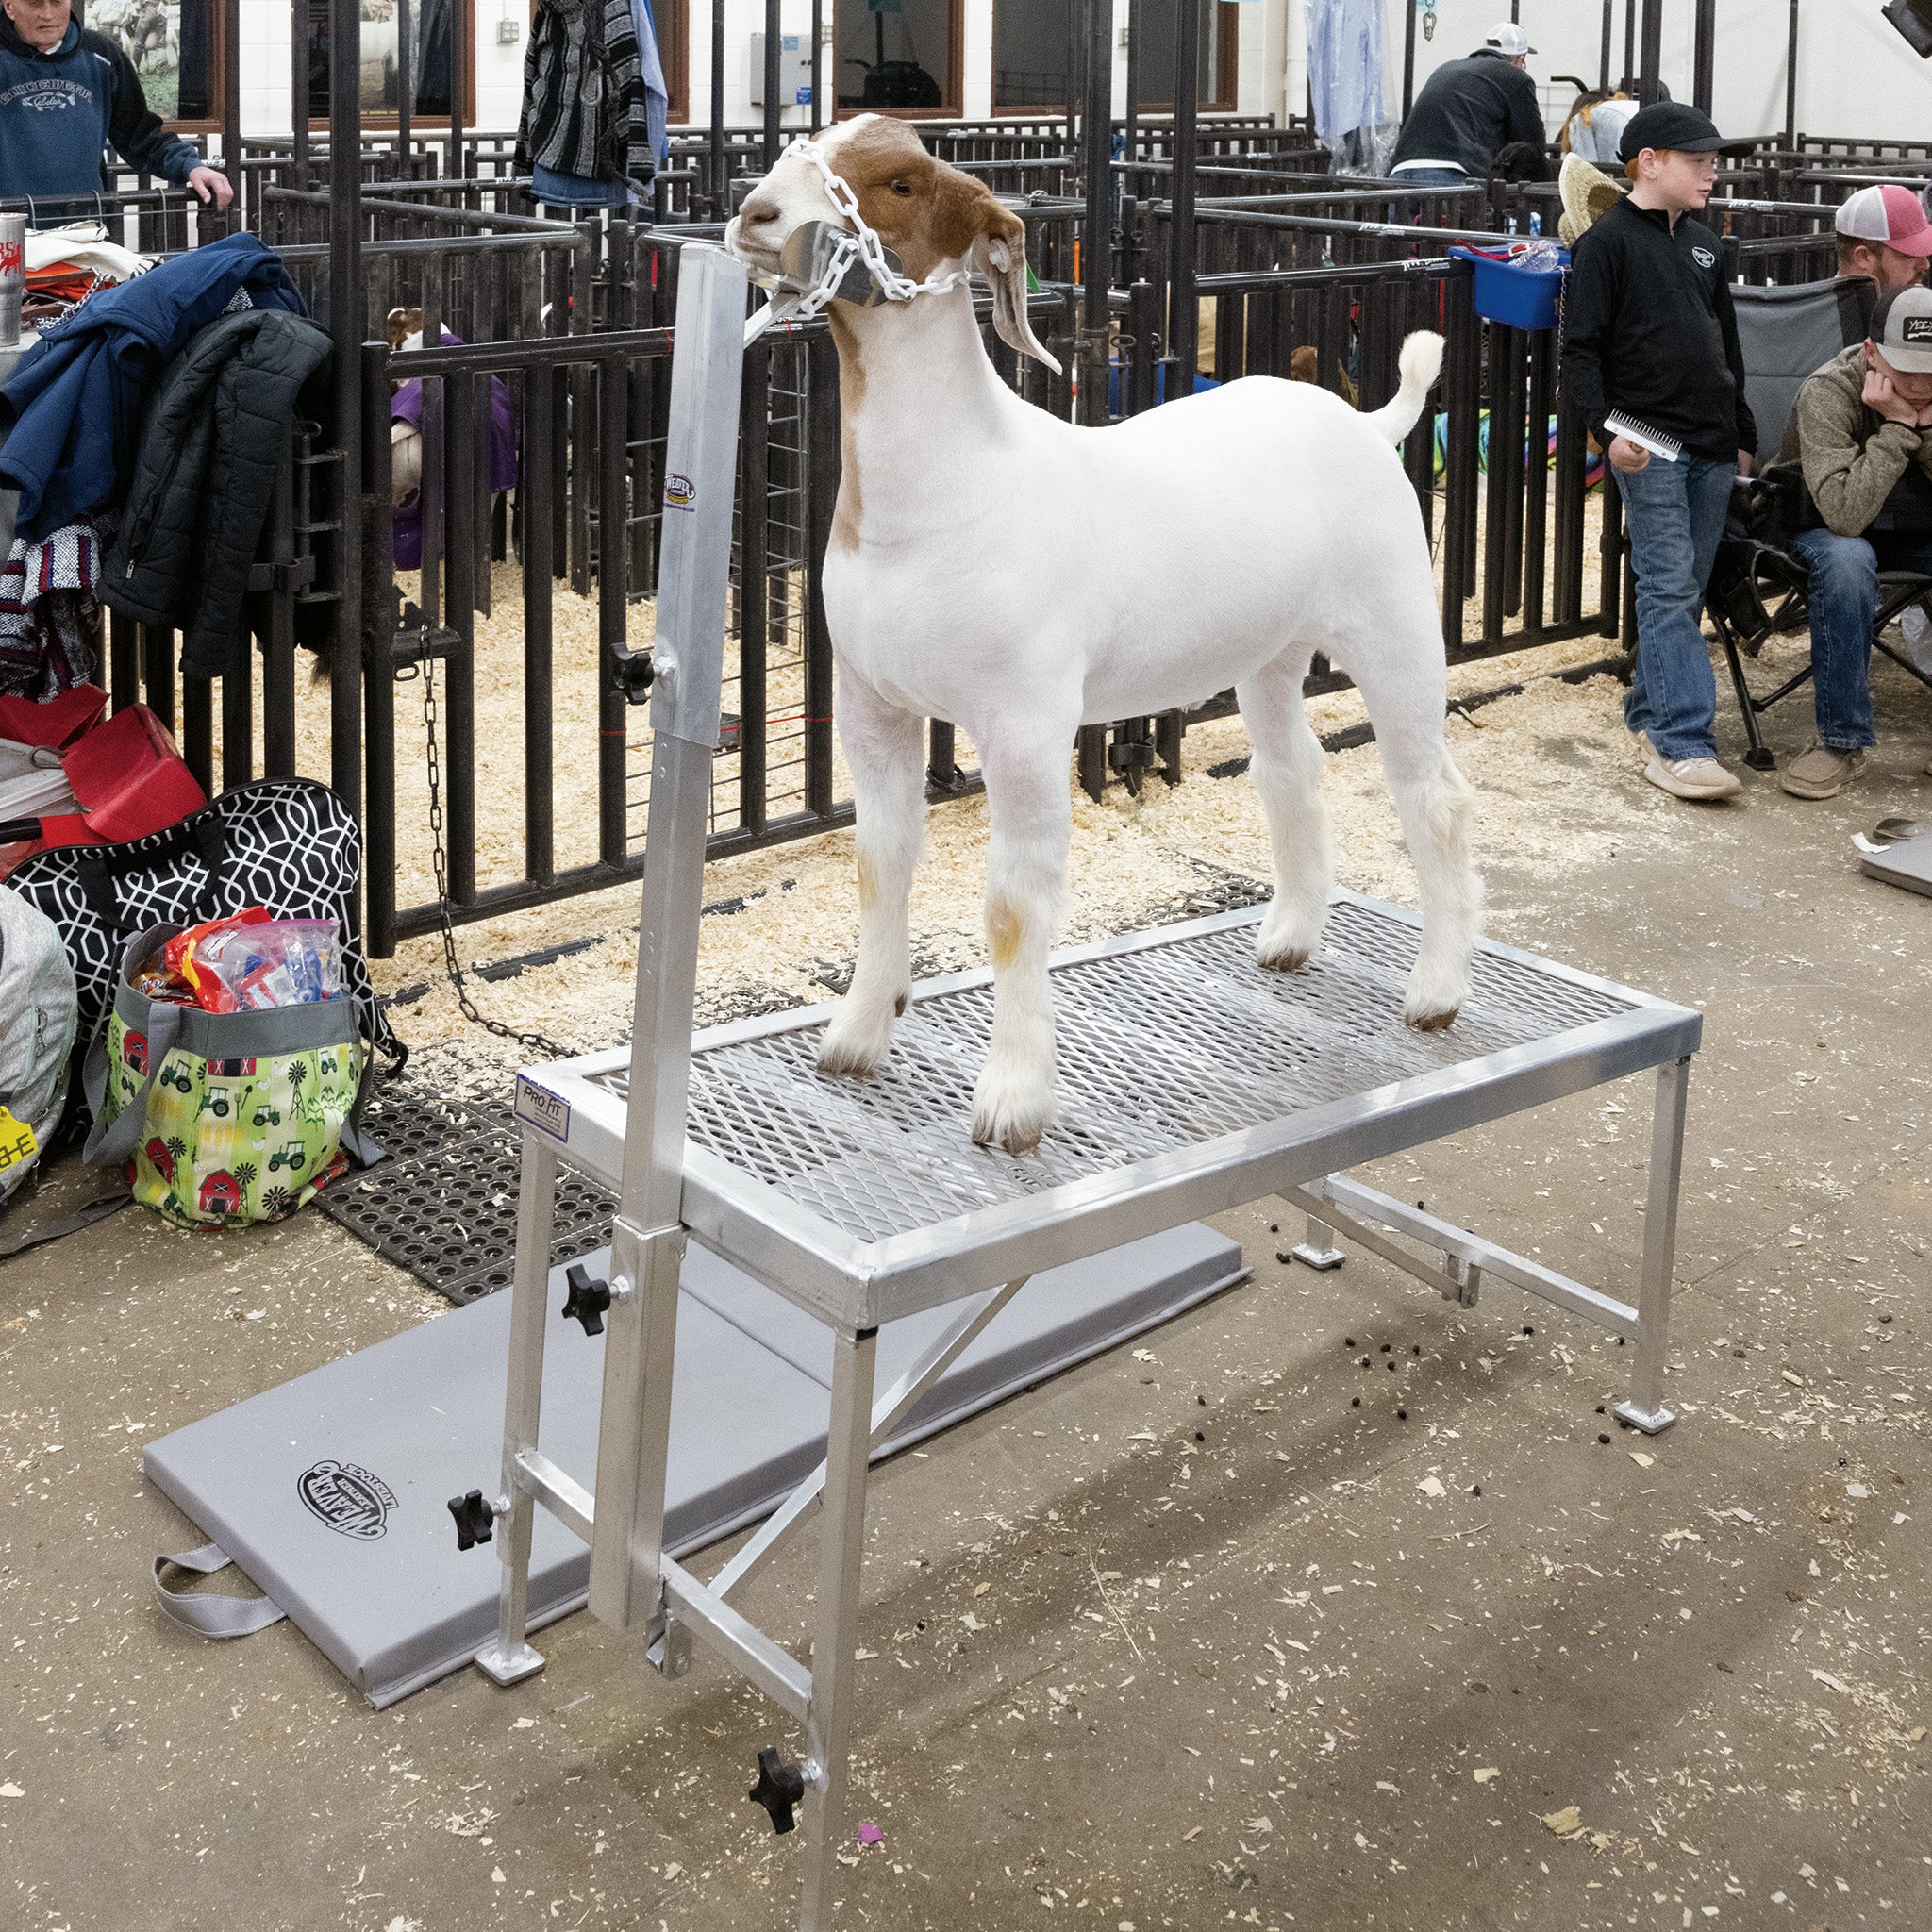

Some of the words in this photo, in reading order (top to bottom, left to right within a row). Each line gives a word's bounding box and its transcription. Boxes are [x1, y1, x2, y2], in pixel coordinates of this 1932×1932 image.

[523, 1086, 545, 1107] PRO
[307, 1461, 386, 1540] WEAVER
[341, 1463, 399, 1510] LIVESTOCK
